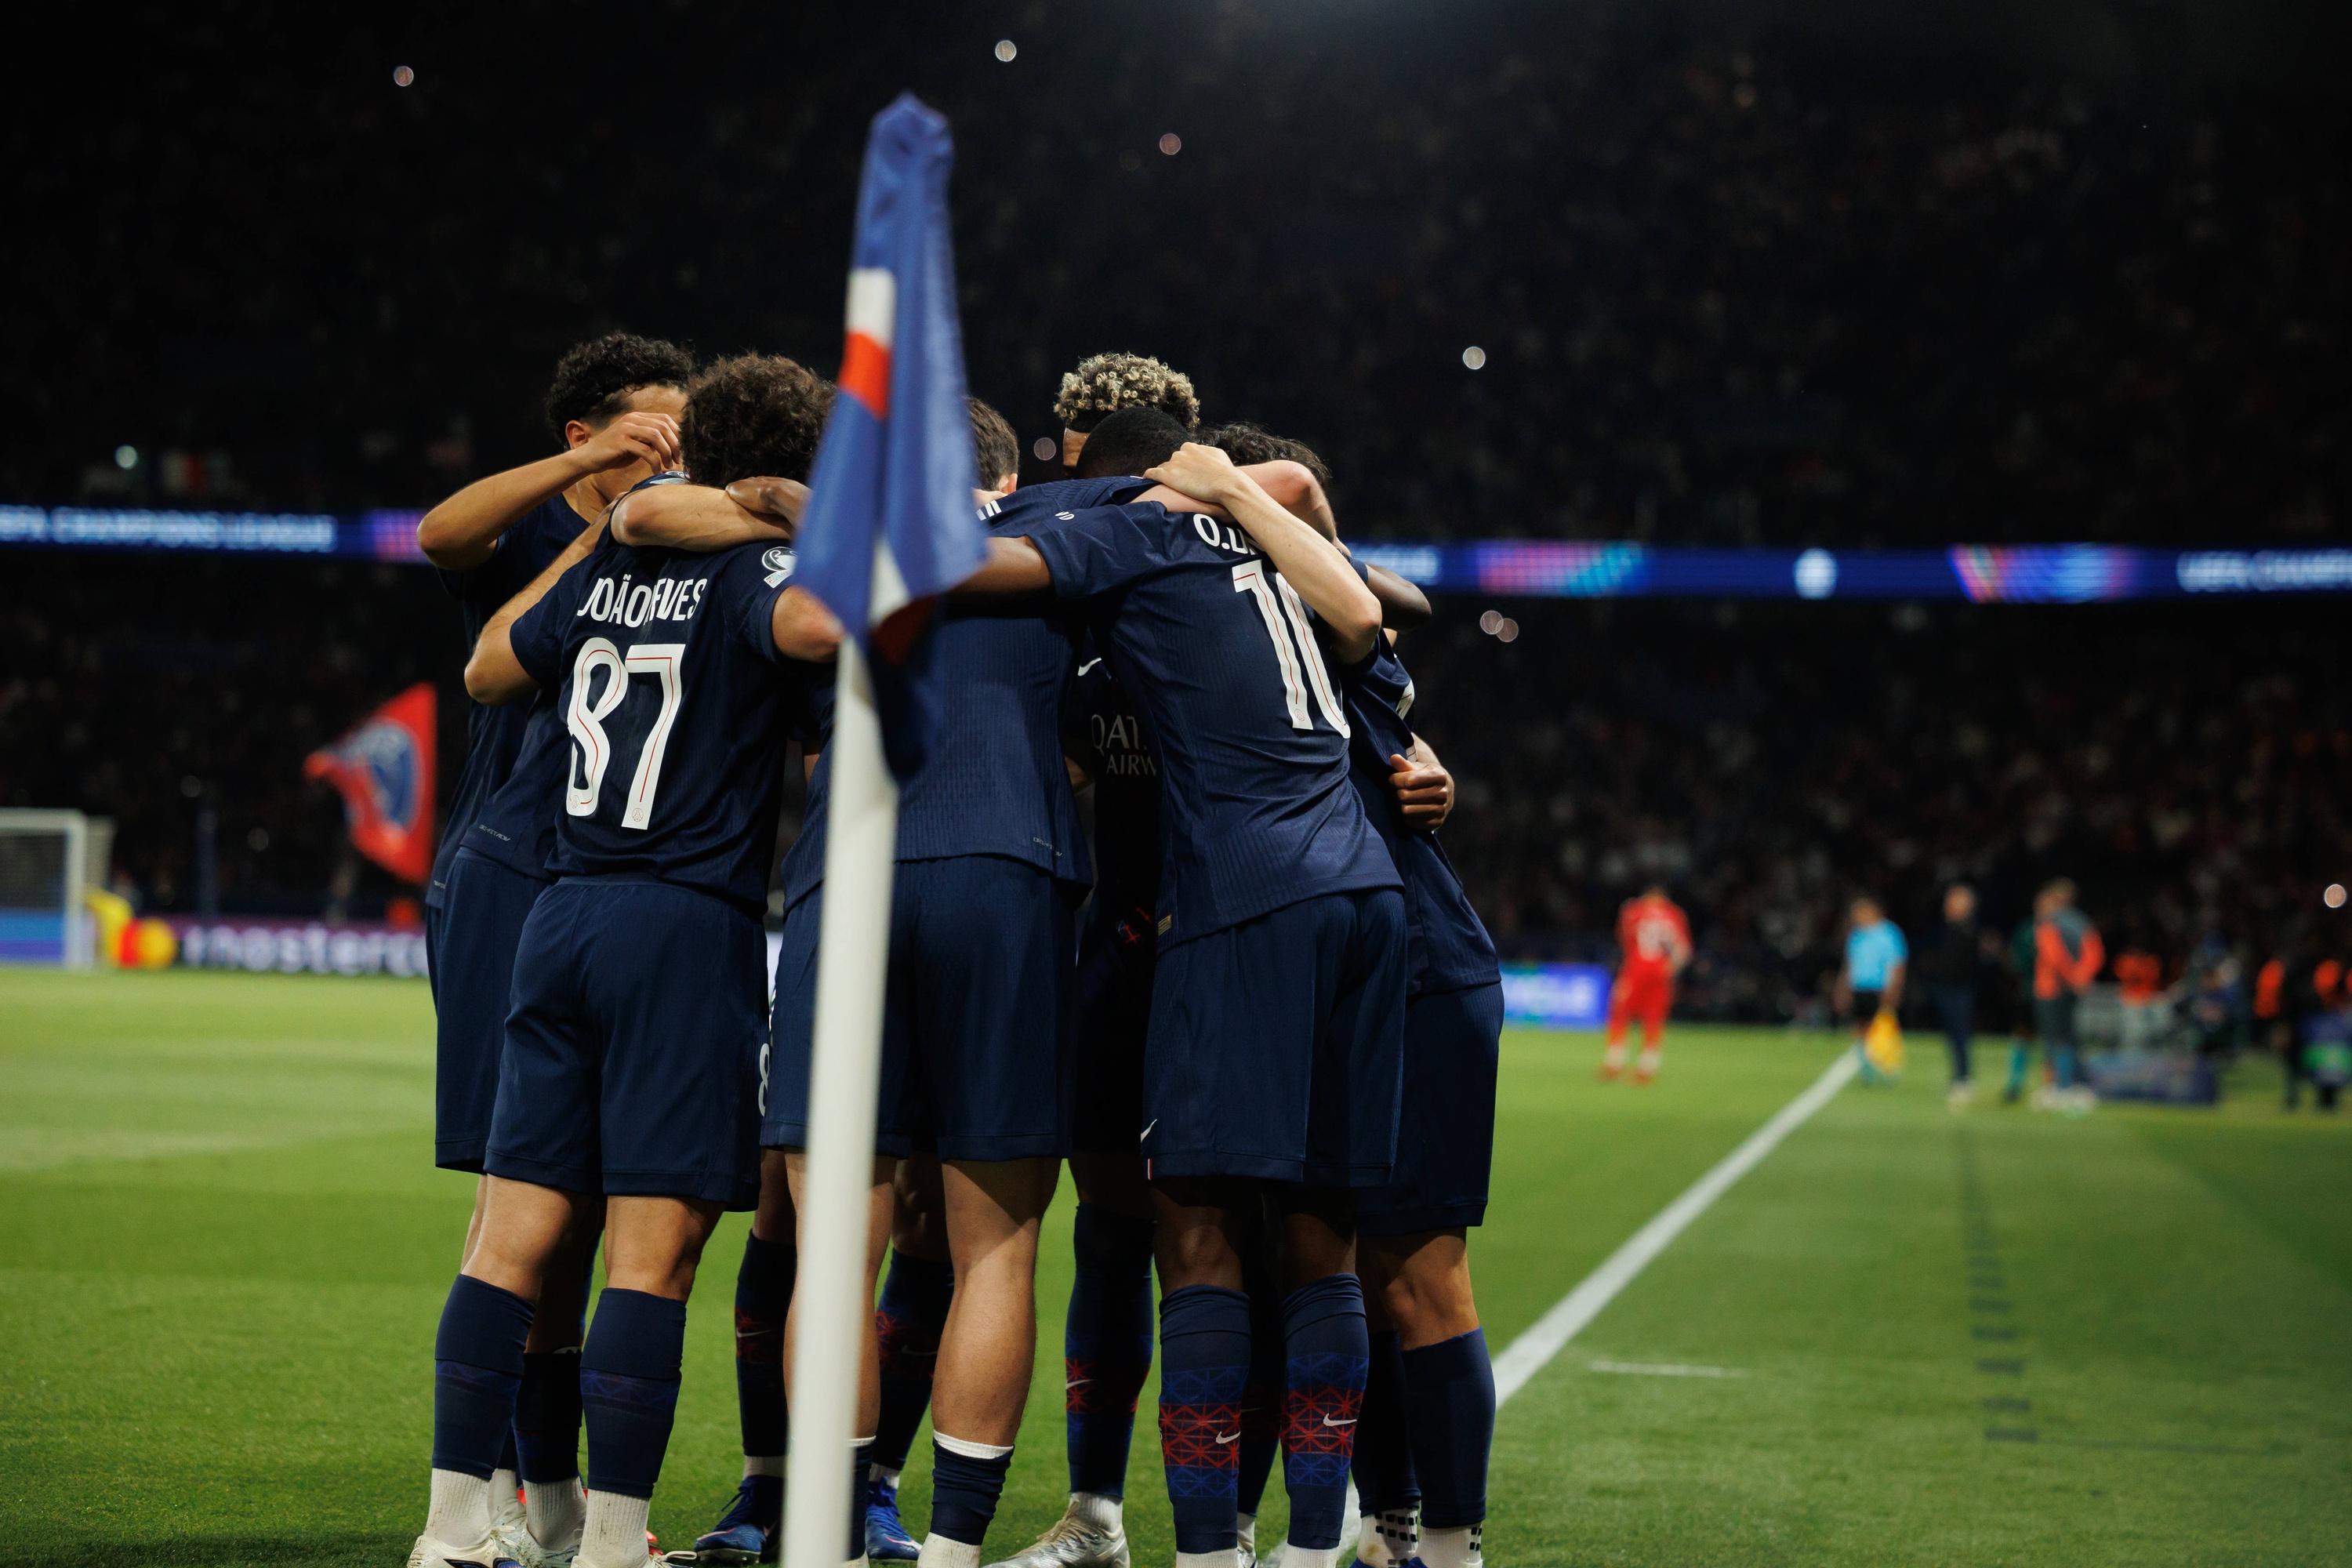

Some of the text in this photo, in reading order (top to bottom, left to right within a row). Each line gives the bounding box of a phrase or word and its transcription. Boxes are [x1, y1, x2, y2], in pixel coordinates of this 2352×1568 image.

[576, 574, 708, 628] JOÃO EVES
[565, 637, 686, 829] 87
[183, 921, 429, 978] masterc
